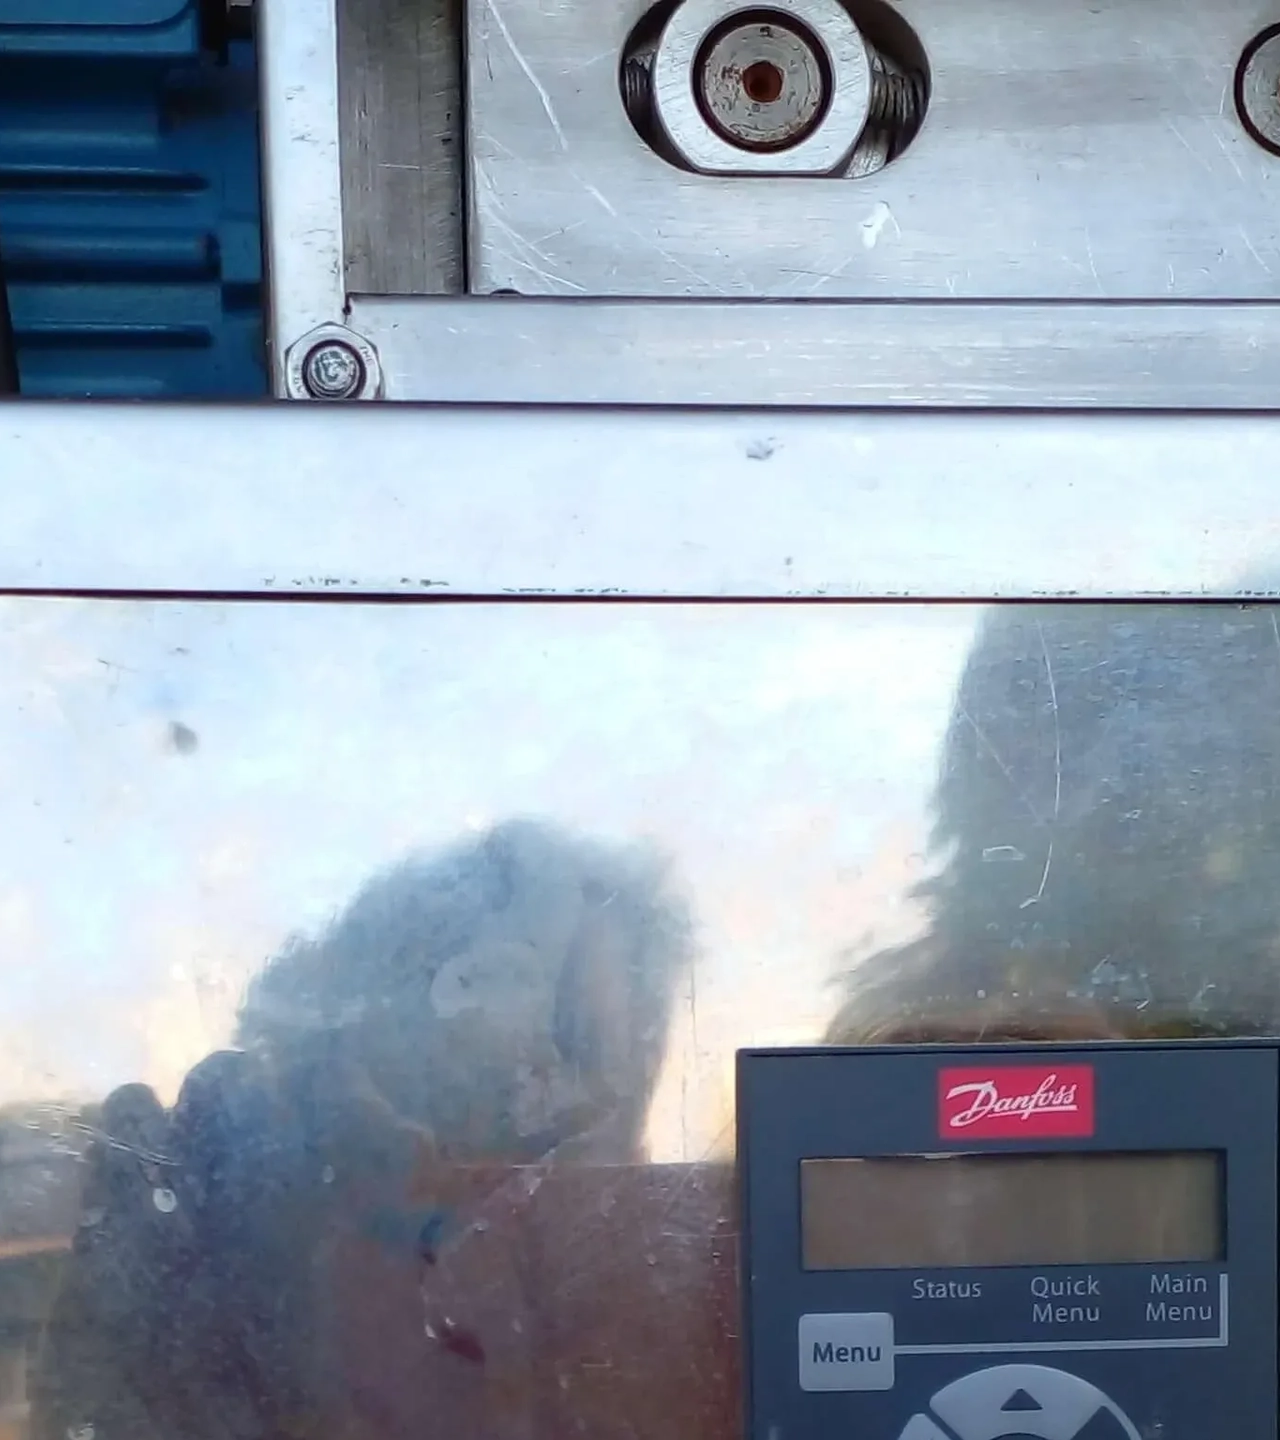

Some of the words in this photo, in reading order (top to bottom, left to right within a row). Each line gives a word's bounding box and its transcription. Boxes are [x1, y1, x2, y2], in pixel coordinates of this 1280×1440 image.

[947, 1075, 1077, 1126] Danfoss
[912, 1279, 981, 1298] Status
[1031, 1275, 1100, 1298] Quick
[1151, 1274, 1206, 1293] Main
[1033, 1303, 1099, 1322] Menu
[1147, 1302, 1211, 1321] Menu
[813, 1343, 880, 1363] Menu
